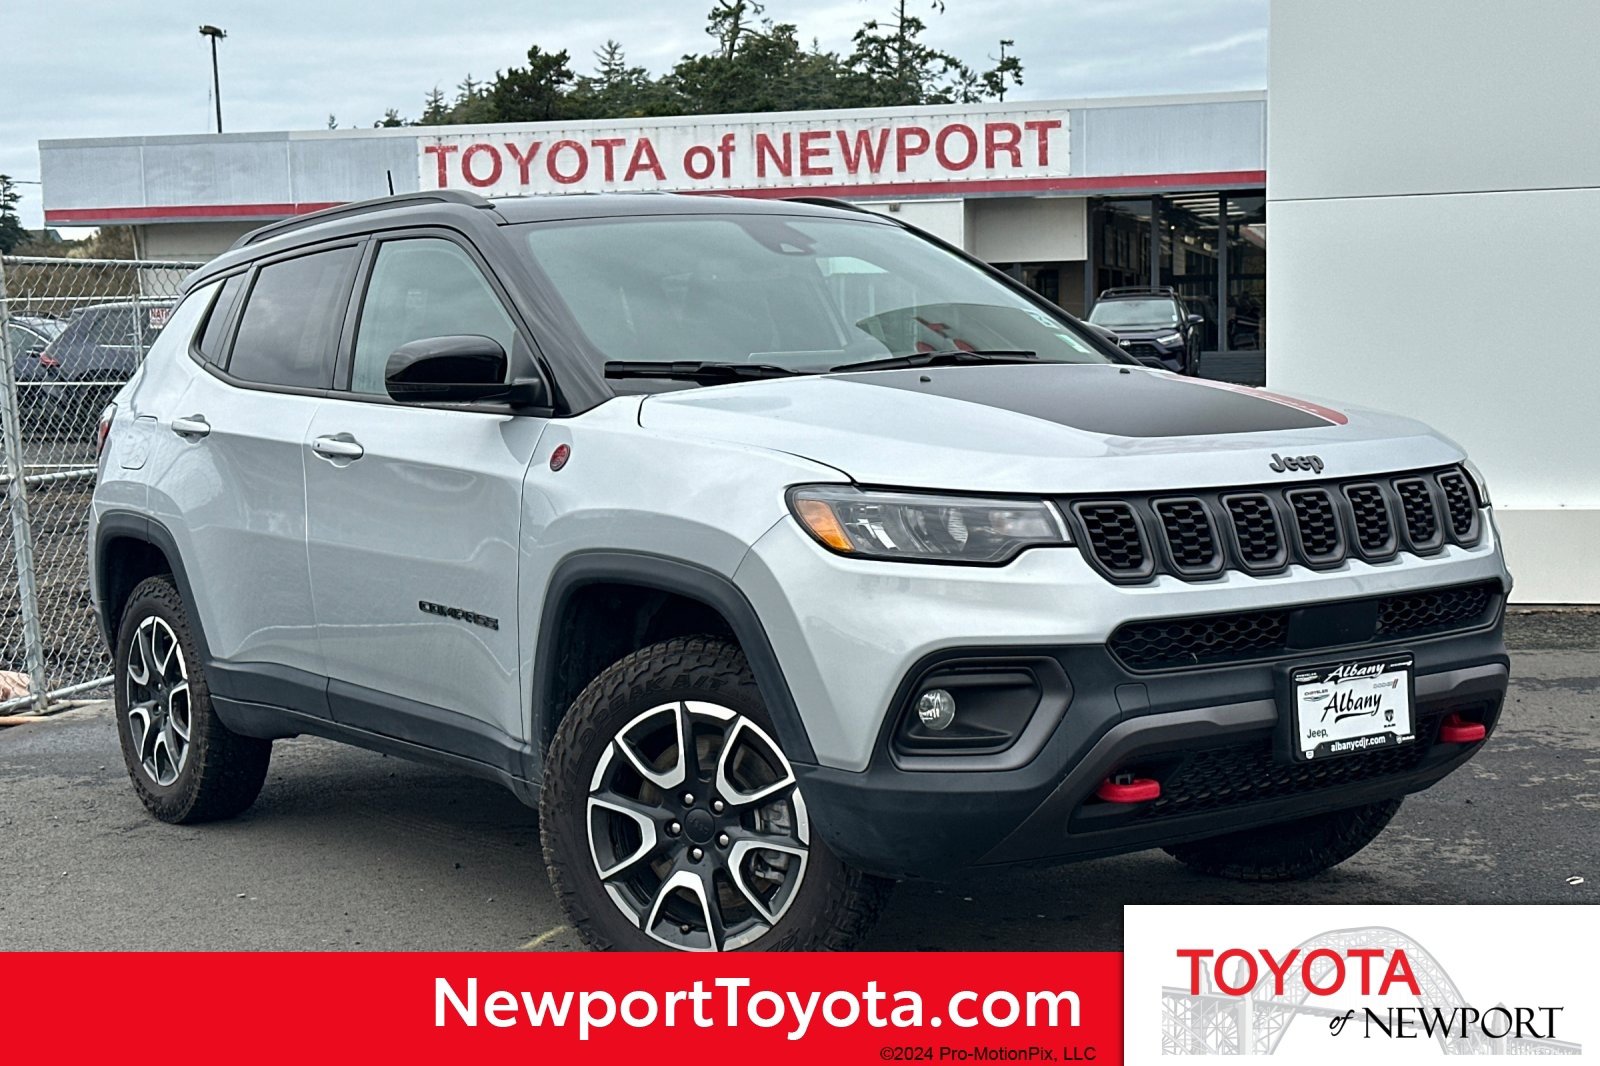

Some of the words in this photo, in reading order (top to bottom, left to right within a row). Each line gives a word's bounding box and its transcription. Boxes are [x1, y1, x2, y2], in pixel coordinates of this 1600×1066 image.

[425, 138, 666, 188] TOYOTA
[684, 133, 735, 180] of
[756, 120, 1062, 176] NEWPORT
[1269, 453, 1325, 474] Jeep
[418, 600, 499, 631] COMPASS
[1323, 664, 1385, 683] Albany
[1321, 689, 1382, 723] Albany
[1331, 735, 1386, 752] albanycdjr.com
